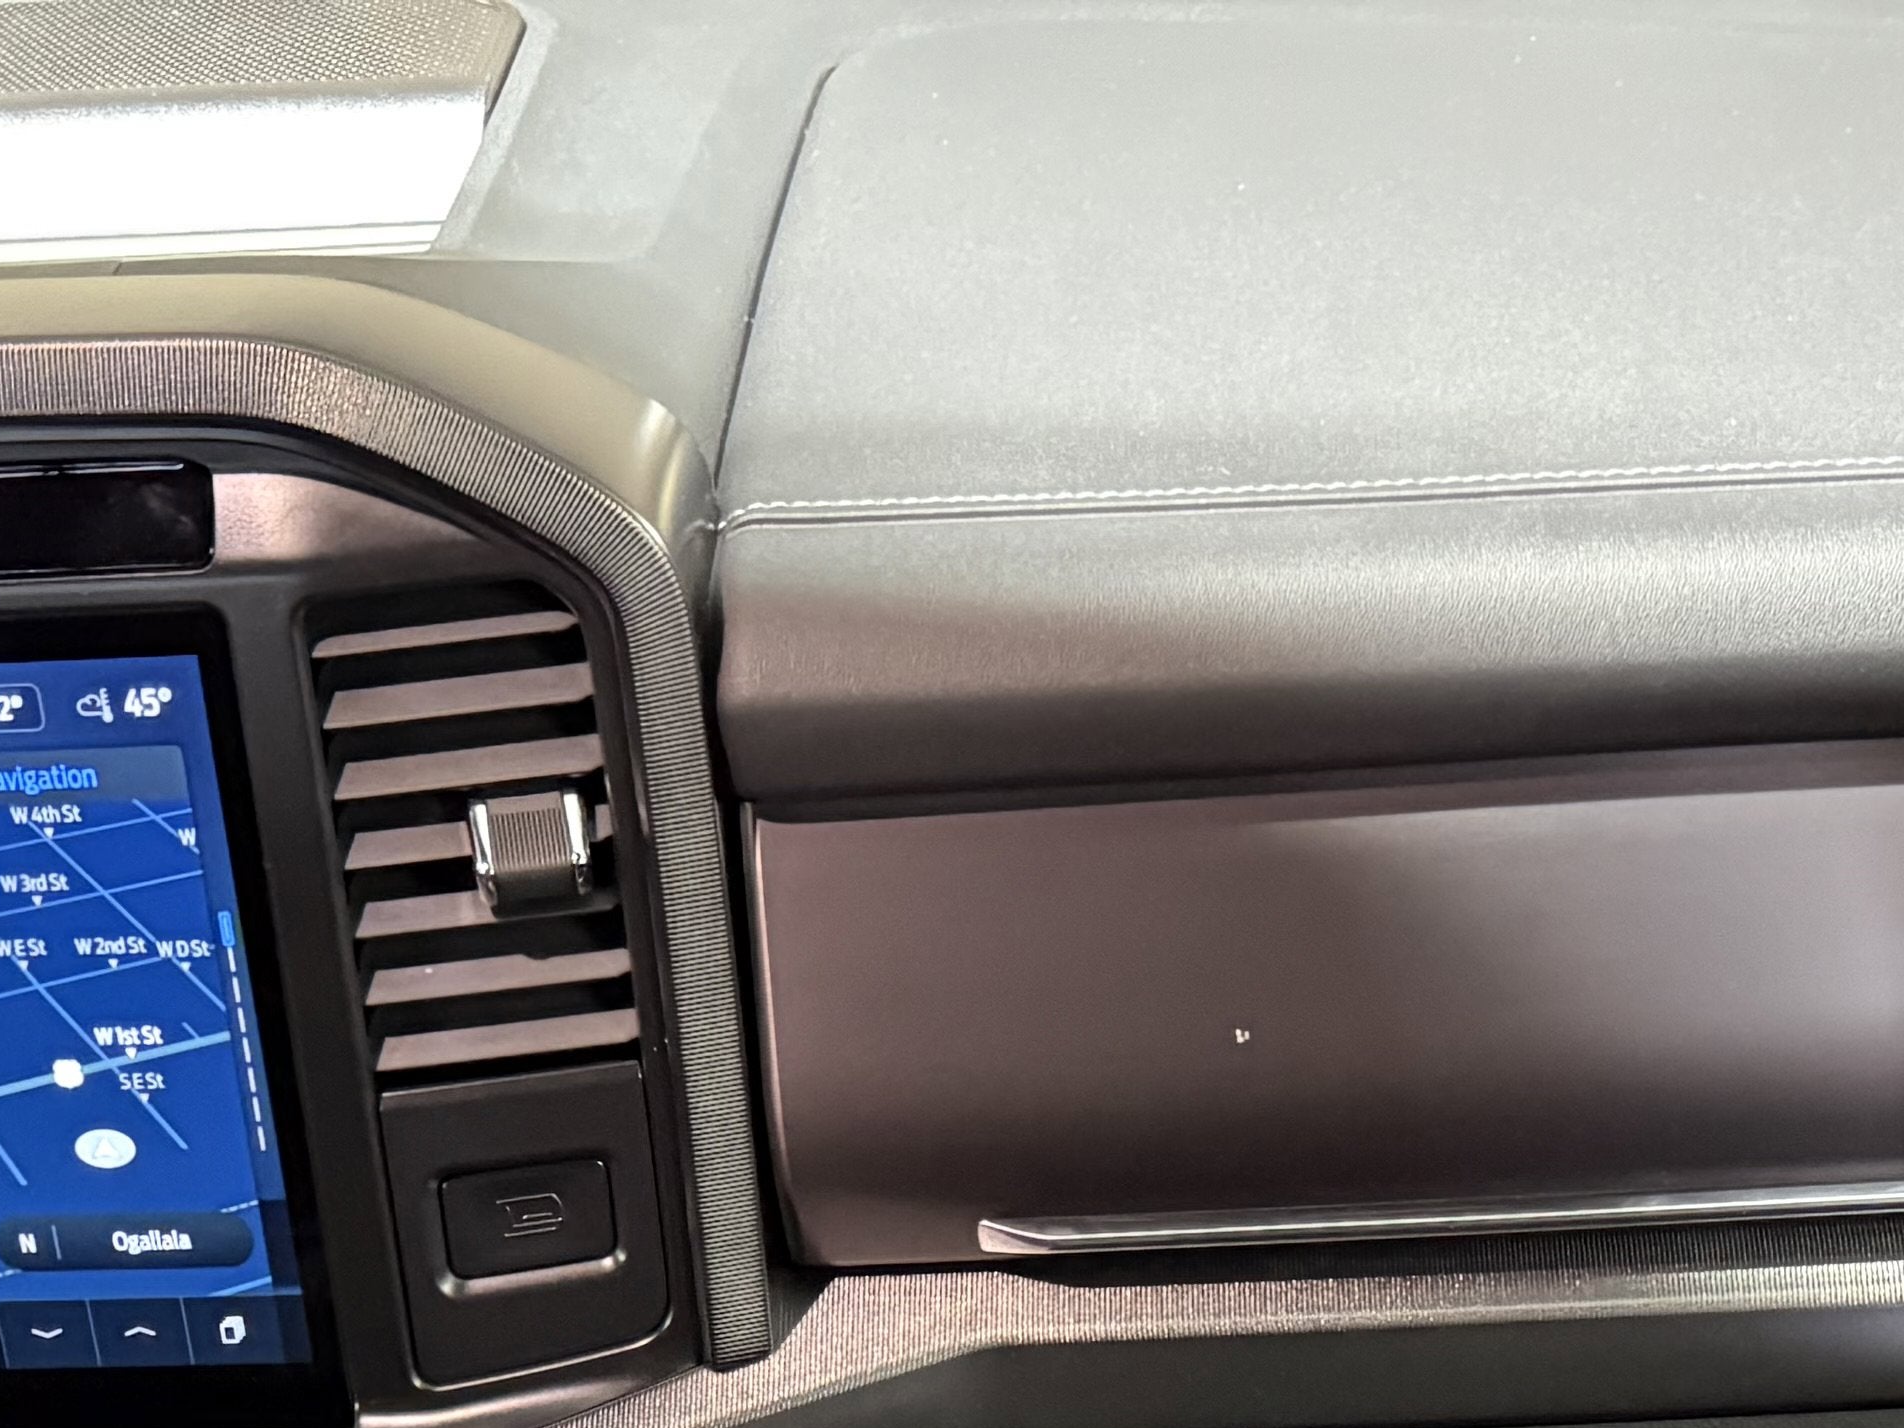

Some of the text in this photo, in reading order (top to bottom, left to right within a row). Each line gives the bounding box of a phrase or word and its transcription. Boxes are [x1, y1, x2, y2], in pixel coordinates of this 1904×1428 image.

[122, 686, 172, 718] 45°
[9, 804, 83, 825] W 4th St
[0, 872, 70, 893] W 3rd St
[13, 938, 26, 956] E
[26, 937, 47, 956] St
[74, 936, 147, 956] W 2nd St
[155, 939, 211, 958] W D St
[94, 1025, 164, 1046] W 1st St
[145, 1072, 166, 1089] St
[18, 1233, 37, 1255] N
[112, 1229, 192, 1257] Ogallala
